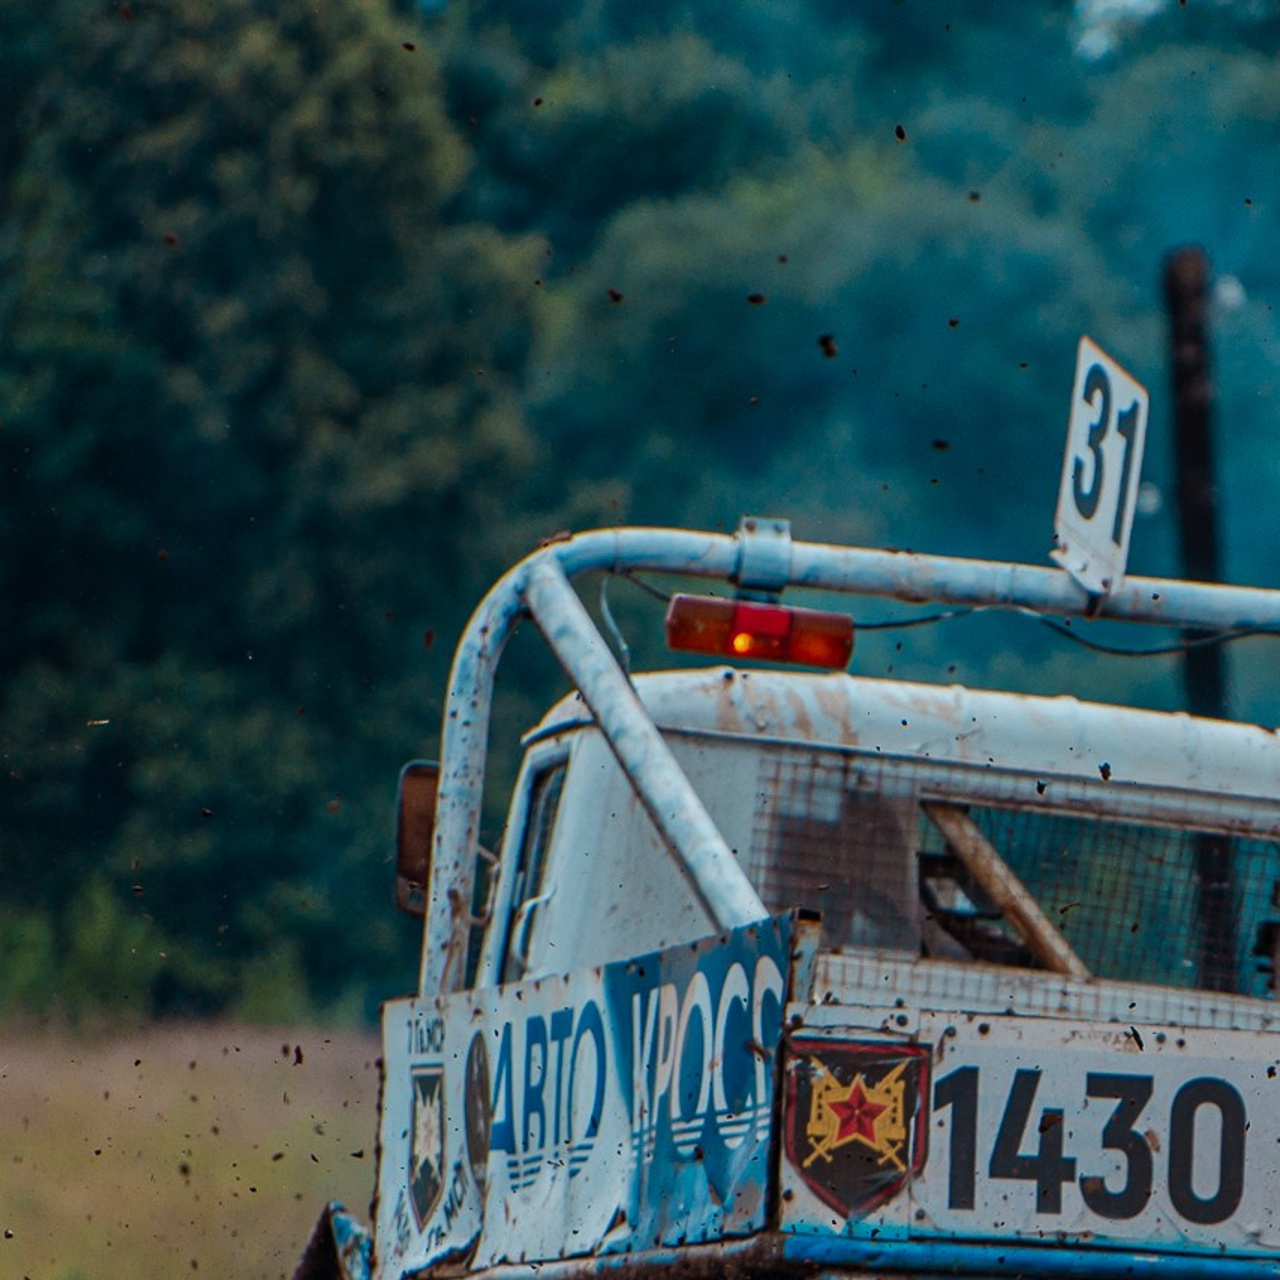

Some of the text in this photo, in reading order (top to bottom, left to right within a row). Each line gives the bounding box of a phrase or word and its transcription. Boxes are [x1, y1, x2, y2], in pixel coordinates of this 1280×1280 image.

[1072, 362, 1140, 548] 31
[489, 955, 784, 1190] АВТО КРОСС
[932, 1065, 1247, 1226] 1430
